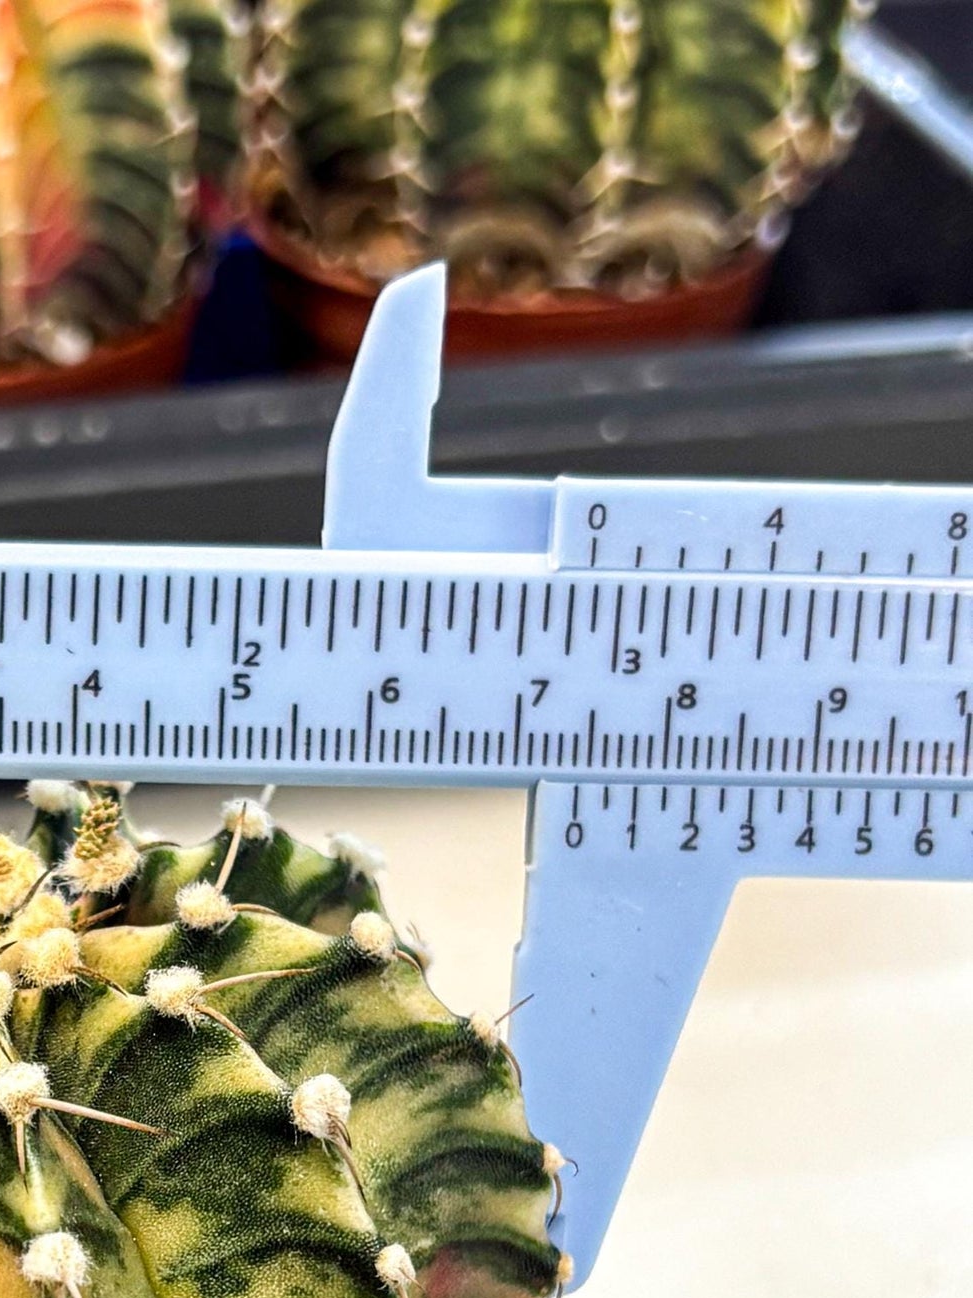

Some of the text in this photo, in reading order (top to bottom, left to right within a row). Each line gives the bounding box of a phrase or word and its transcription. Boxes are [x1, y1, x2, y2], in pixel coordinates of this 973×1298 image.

[588, 504, 969, 540] 0 4 8
[242, 642, 263, 667] 2
[621, 649, 642, 674] 3
[81, 670, 103, 696] 4
[231, 674, 252, 700] 5
[379, 678, 401, 703] 6
[529, 680, 550, 706] 7
[675, 684, 698, 708] 8
[828, 688, 849, 713] 9
[564, 822, 934, 856] 0 1 2 3 4 5 6
